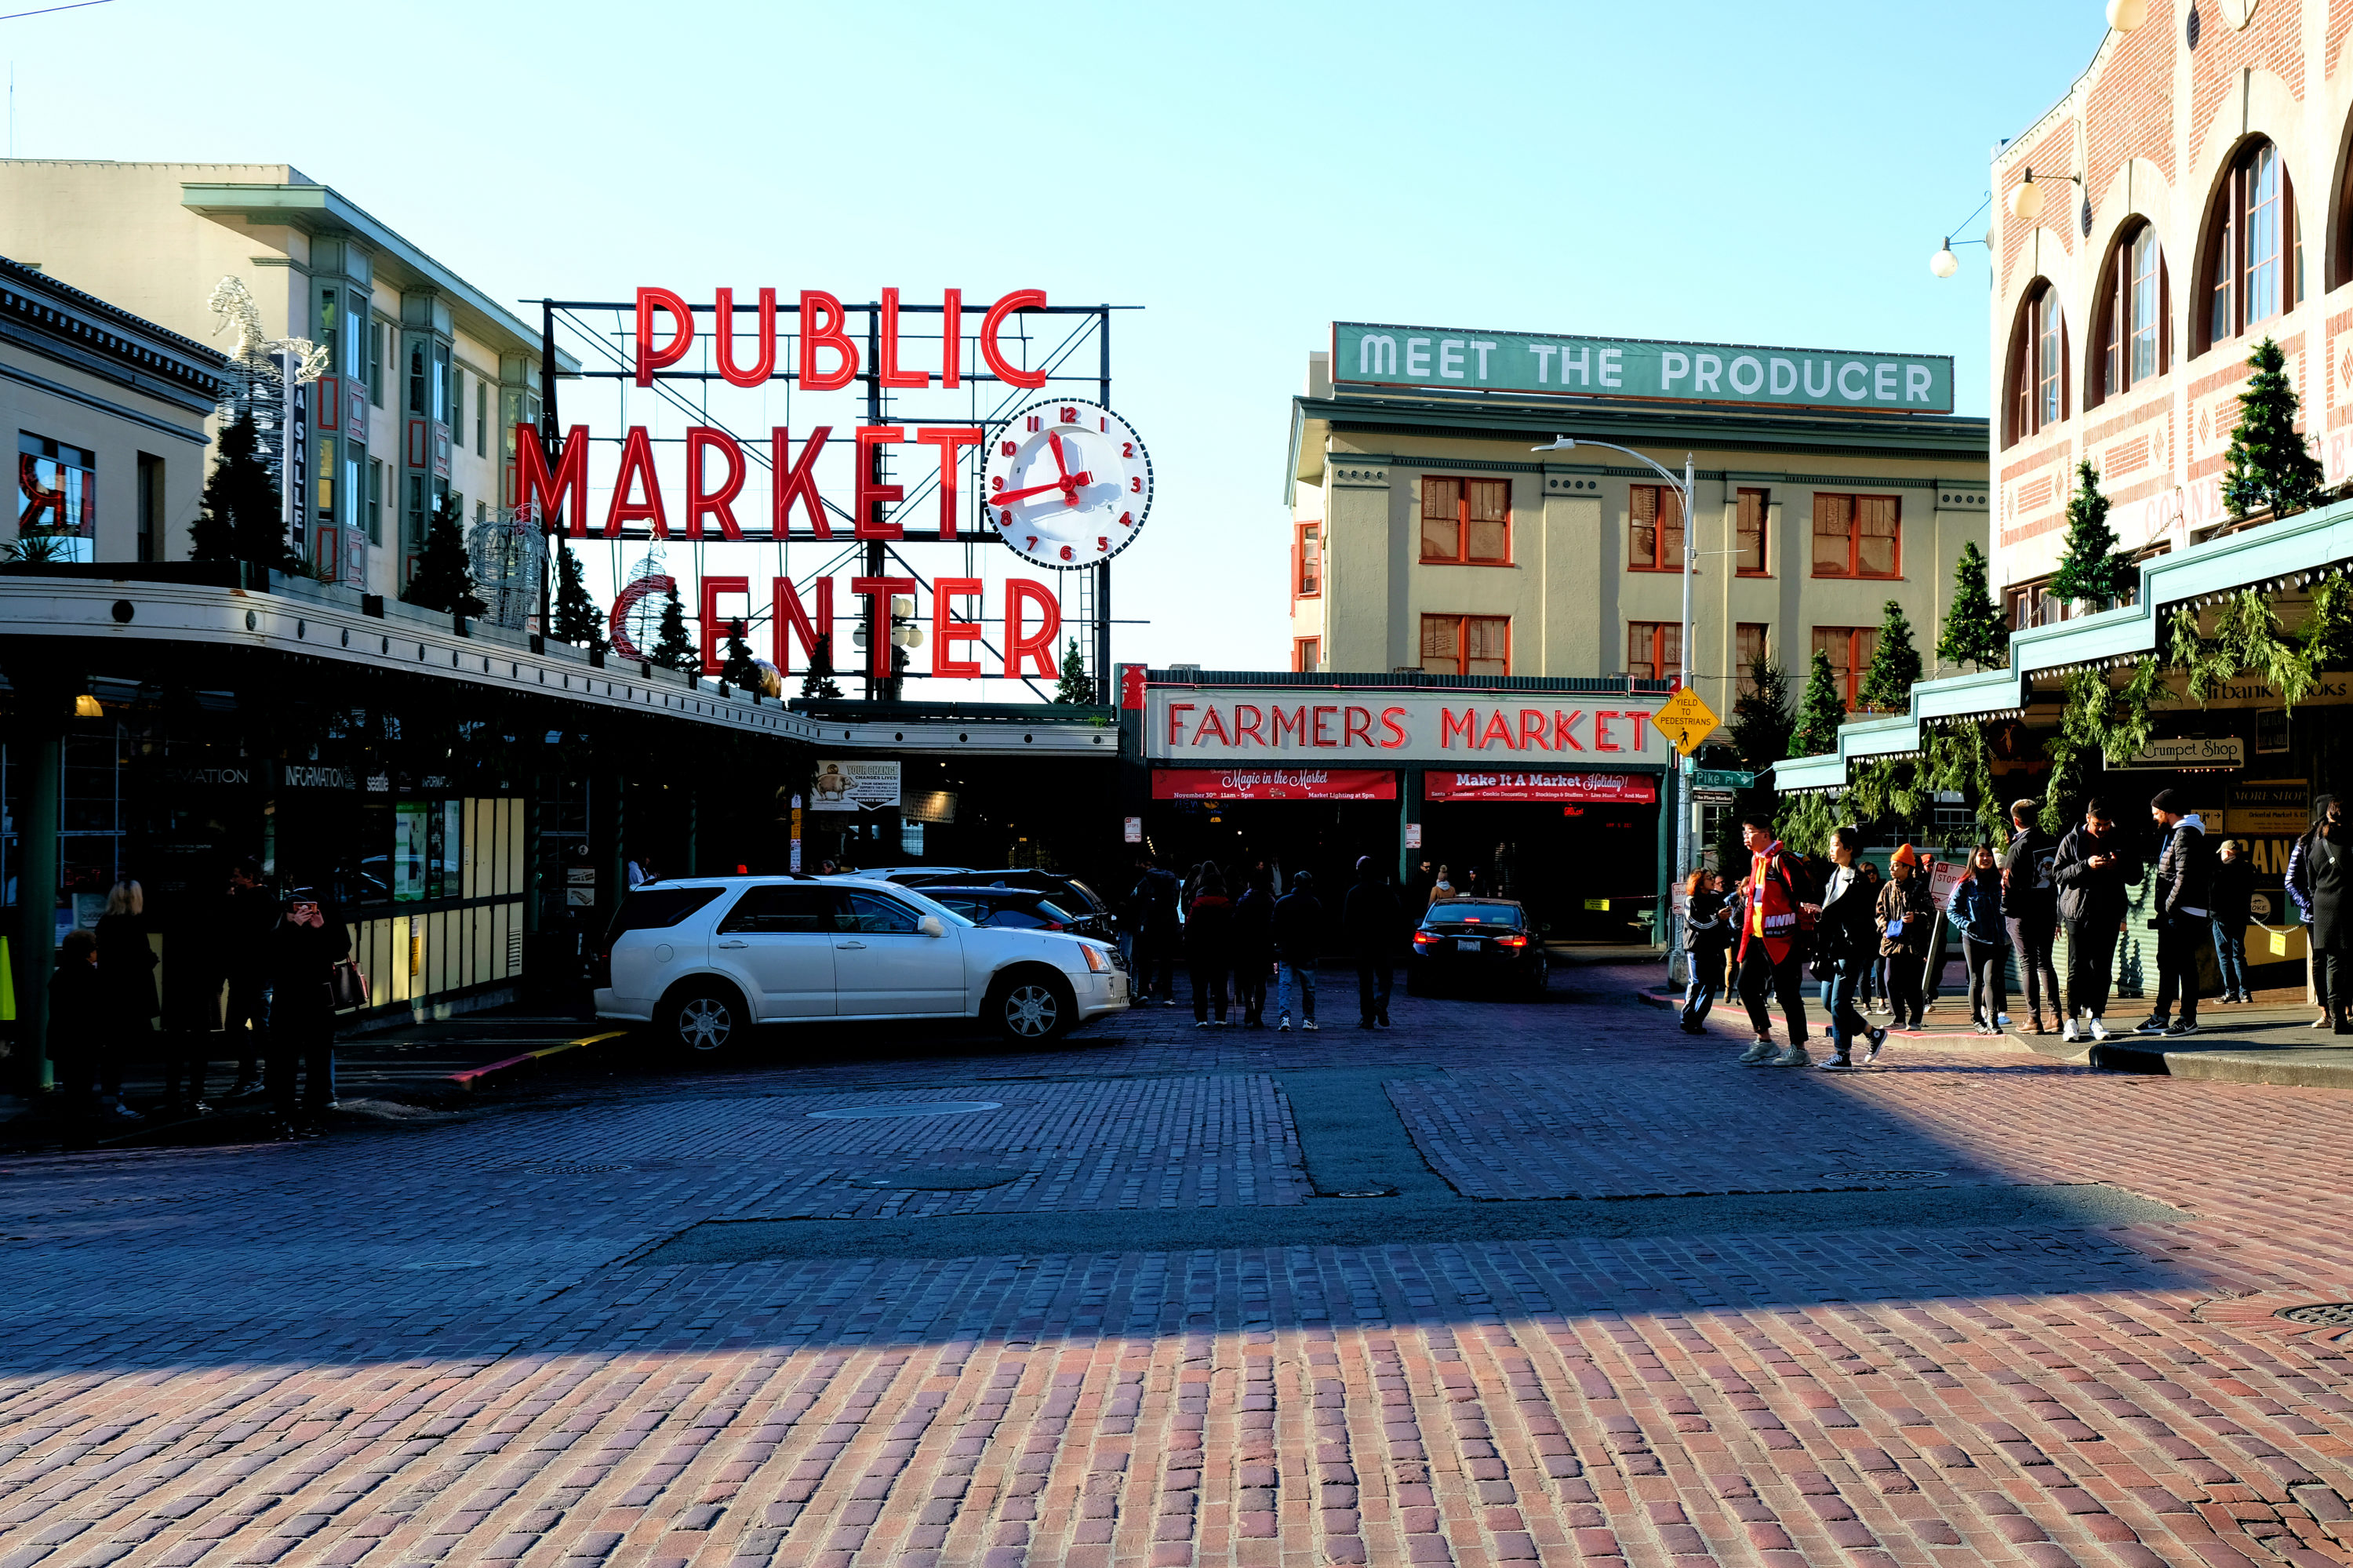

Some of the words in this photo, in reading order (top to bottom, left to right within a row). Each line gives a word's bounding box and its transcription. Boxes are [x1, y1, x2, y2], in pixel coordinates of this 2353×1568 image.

[635, 286, 1047, 391] PUBLIC
[1359, 333, 1497, 380] MEET
[1529, 344, 1622, 387] THE
[1661, 351, 1933, 402] PRODUCER
[1060, 407, 1076, 423] 12
[1027, 417, 1038, 431] 11
[1100, 417, 1105, 432] 1
[1002, 441, 1016, 457] 10
[1122, 442, 1133, 457] 2
[515, 422, 983, 541] MARKET
[992, 476, 1004, 491] 9
[1130, 477, 1141, 493] 3
[1000, 510, 1013, 526] 8
[1118, 511, 1132, 526] 4
[1026, 537, 1038, 551] 7
[1096, 537, 1107, 551] 5
[1060, 545, 1071, 561] 6
[609, 575, 1062, 679] CENTER
[1169, 703, 1406, 749] FARMERS
[1442, 708, 1652, 751] MARKET
[1660, 717, 1711, 726] PEDESTRIANS
[2202, 740, 2238, 760] Shop
[1222, 769, 1260, 791] Magic
[1262, 770, 1272, 784] in
[1274, 769, 1288, 784] the
[1289, 769, 1327, 790] Market
[1457, 773, 1497, 786] Make
[1500, 774, 1512, 786] It
[1515, 774, 1526, 786] A
[1529, 774, 1581, 787] Market
[1583, 773, 1628, 792] Holiday!
[1697, 772, 1720, 784] Pike
[1764, 912, 1796, 929] MWM
